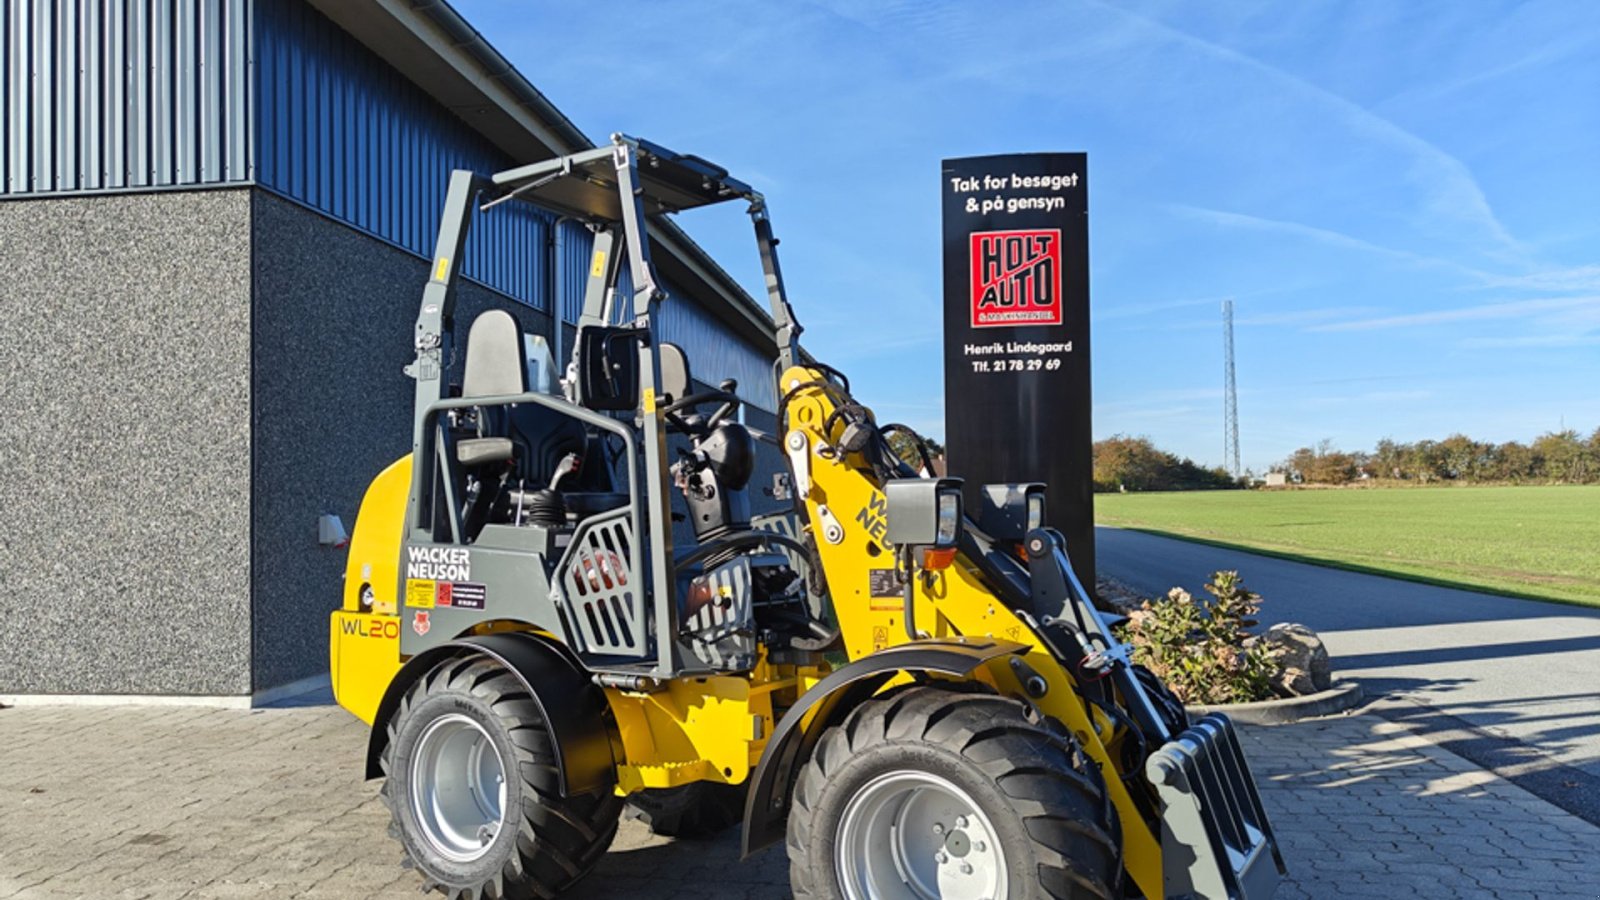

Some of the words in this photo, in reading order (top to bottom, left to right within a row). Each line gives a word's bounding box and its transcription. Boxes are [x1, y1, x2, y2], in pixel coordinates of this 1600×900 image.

[951, 177, 980, 193] Tak
[984, 175, 1009, 190] for
[1012, 172, 1079, 191] besøget
[965, 197, 979, 213] &
[982, 195, 1004, 216] på
[1007, 195, 1065, 214] gensyn
[980, 234, 1054, 287] HOLT
[978, 257, 1055, 309] AUTO
[964, 343, 1004, 356] Henrik
[1007, 341, 1073, 356] Lindegaard
[993, 360, 1006, 372] 21
[1009, 360, 1024, 372] 78
[1026, 360, 1042, 372] 29
[1045, 359, 1061, 371] 69
[408, 546, 470, 564] WACKER
[407, 564, 470, 581] NEUSON
[341, 617, 399, 639] WL20
